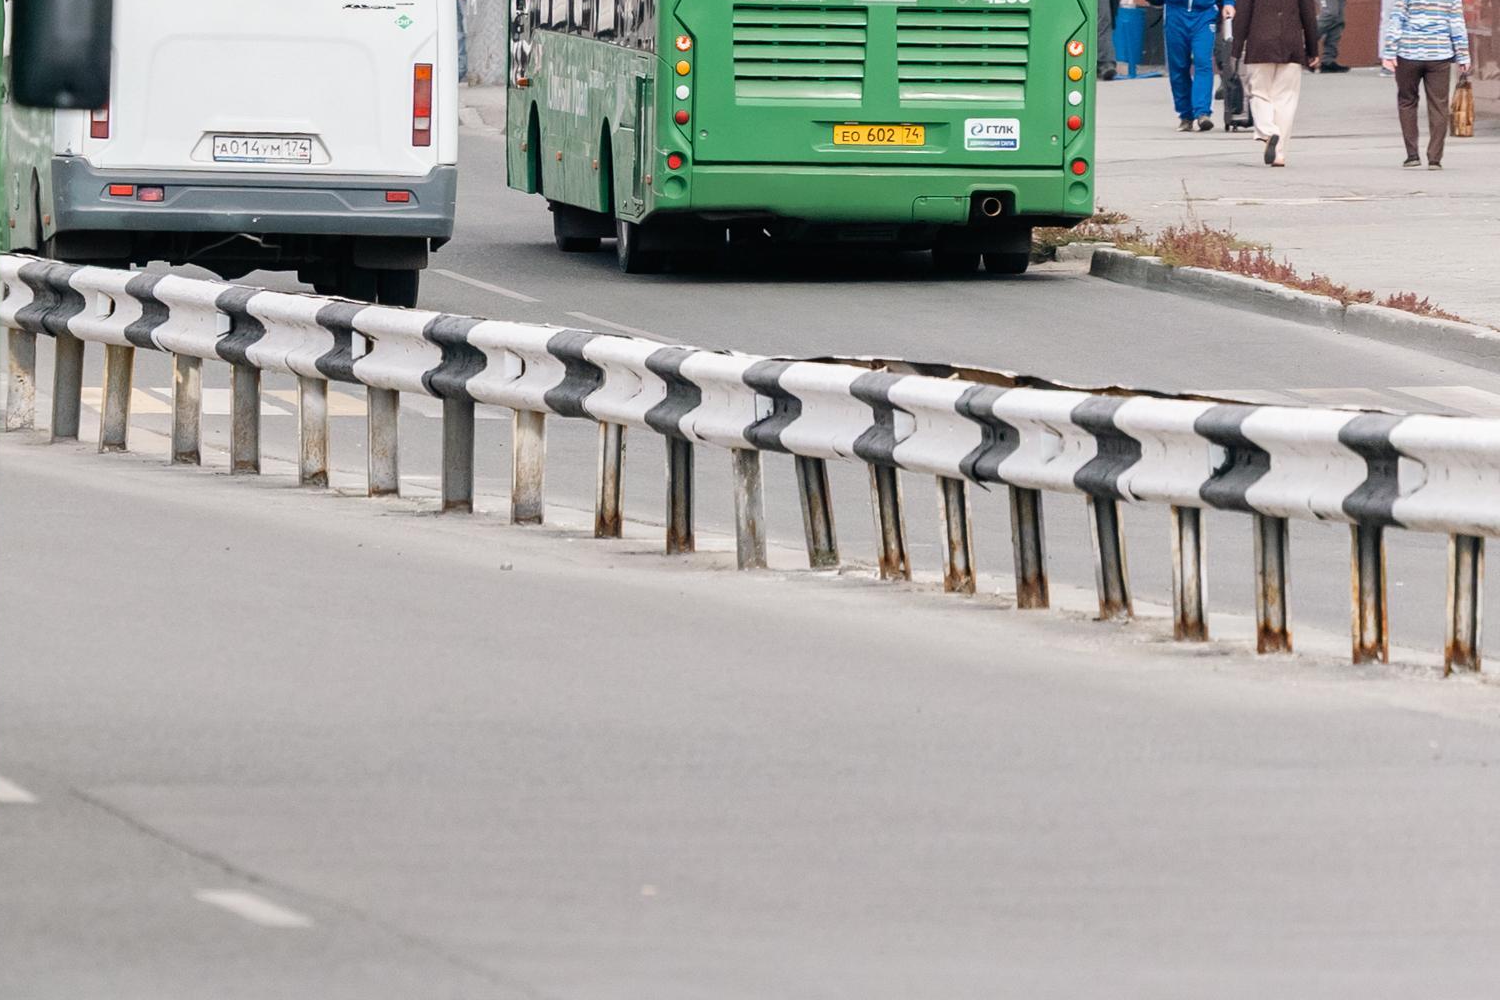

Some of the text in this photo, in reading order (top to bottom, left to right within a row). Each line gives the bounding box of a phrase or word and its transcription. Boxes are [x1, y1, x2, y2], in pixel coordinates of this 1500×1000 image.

[842, 128, 919, 142] ЕО 602 74
[986, 125, 1013, 134] ГТЛК
[285, 140, 307, 152] 174
